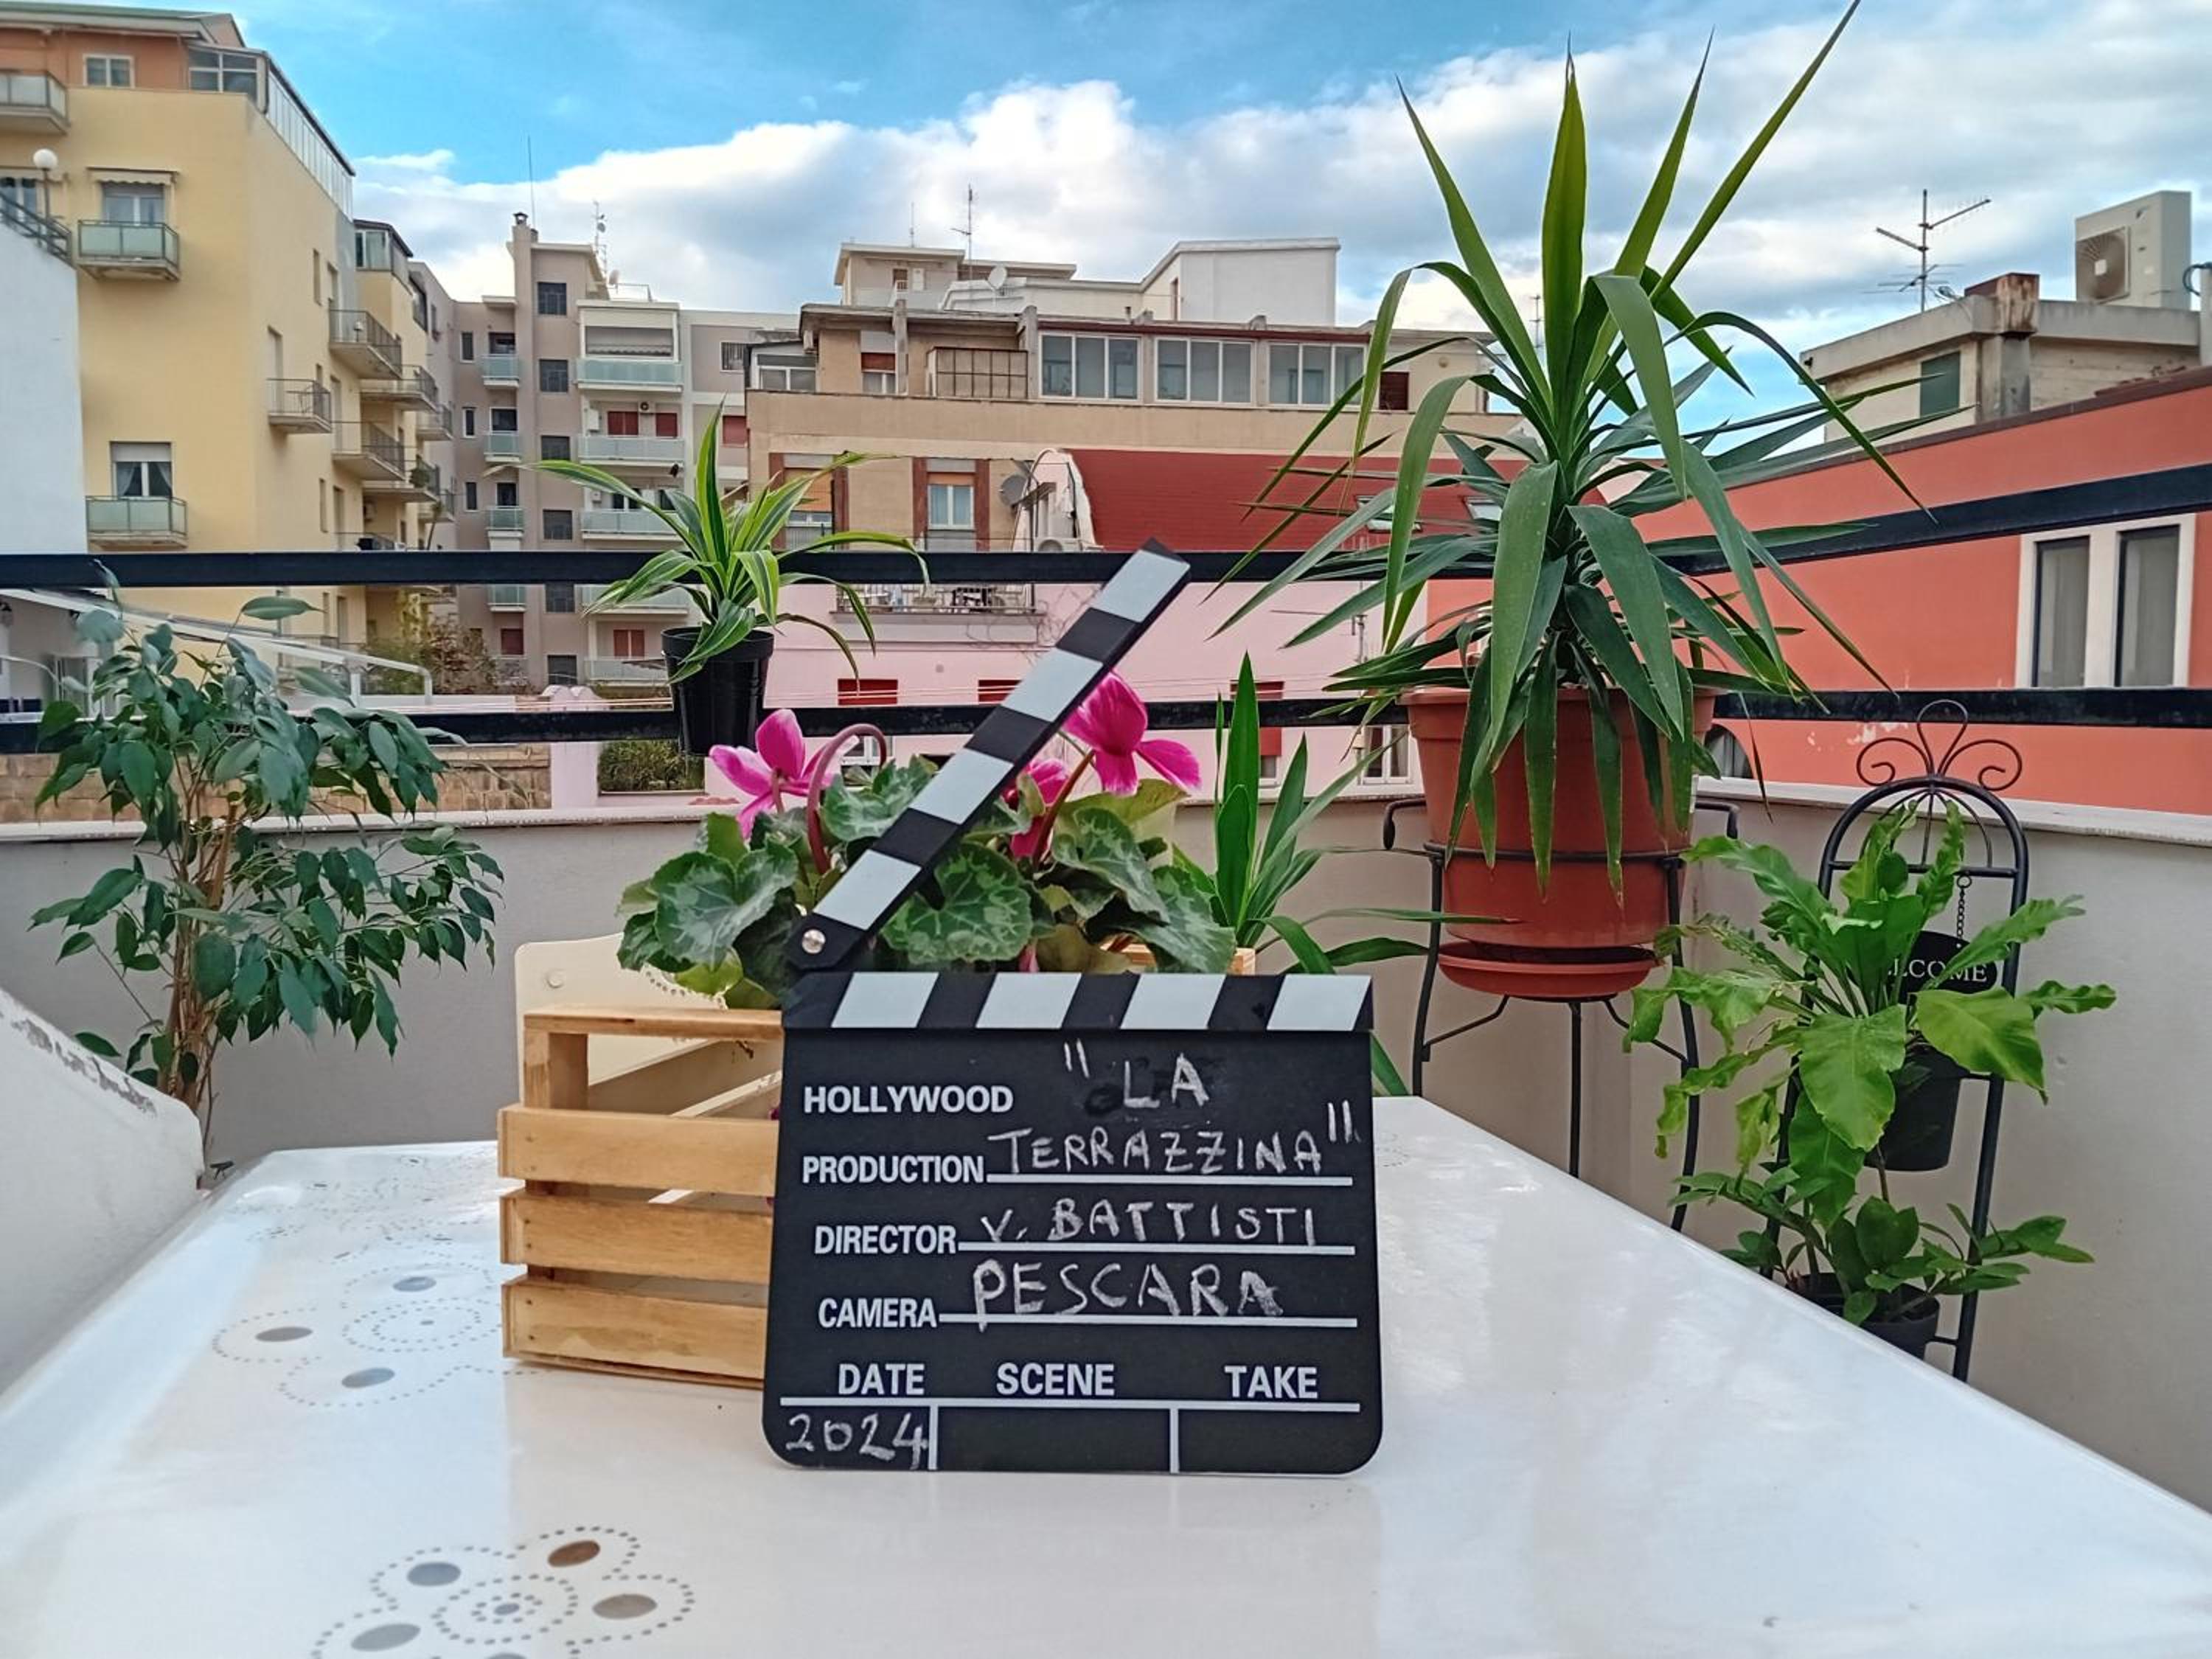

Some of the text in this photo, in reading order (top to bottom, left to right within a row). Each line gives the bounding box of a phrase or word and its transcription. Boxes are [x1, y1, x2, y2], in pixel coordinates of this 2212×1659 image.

[803, 1085, 1014, 1114] HOLLYWOOD
[802, 1155, 984, 1183] PRODUCTION
[1047, 1197, 1316, 1246] BATTISTI
[815, 1225, 957, 1254] DIRECTOR
[973, 1259, 1284, 1333] PESCARA
[818, 1298, 937, 1328] CAMERA
[838, 1364, 925, 1395] DATE
[996, 1364, 1115, 1397] SCENE
[1224, 1366, 1318, 1399] TAKE
[785, 1413, 928, 1470] 2024
